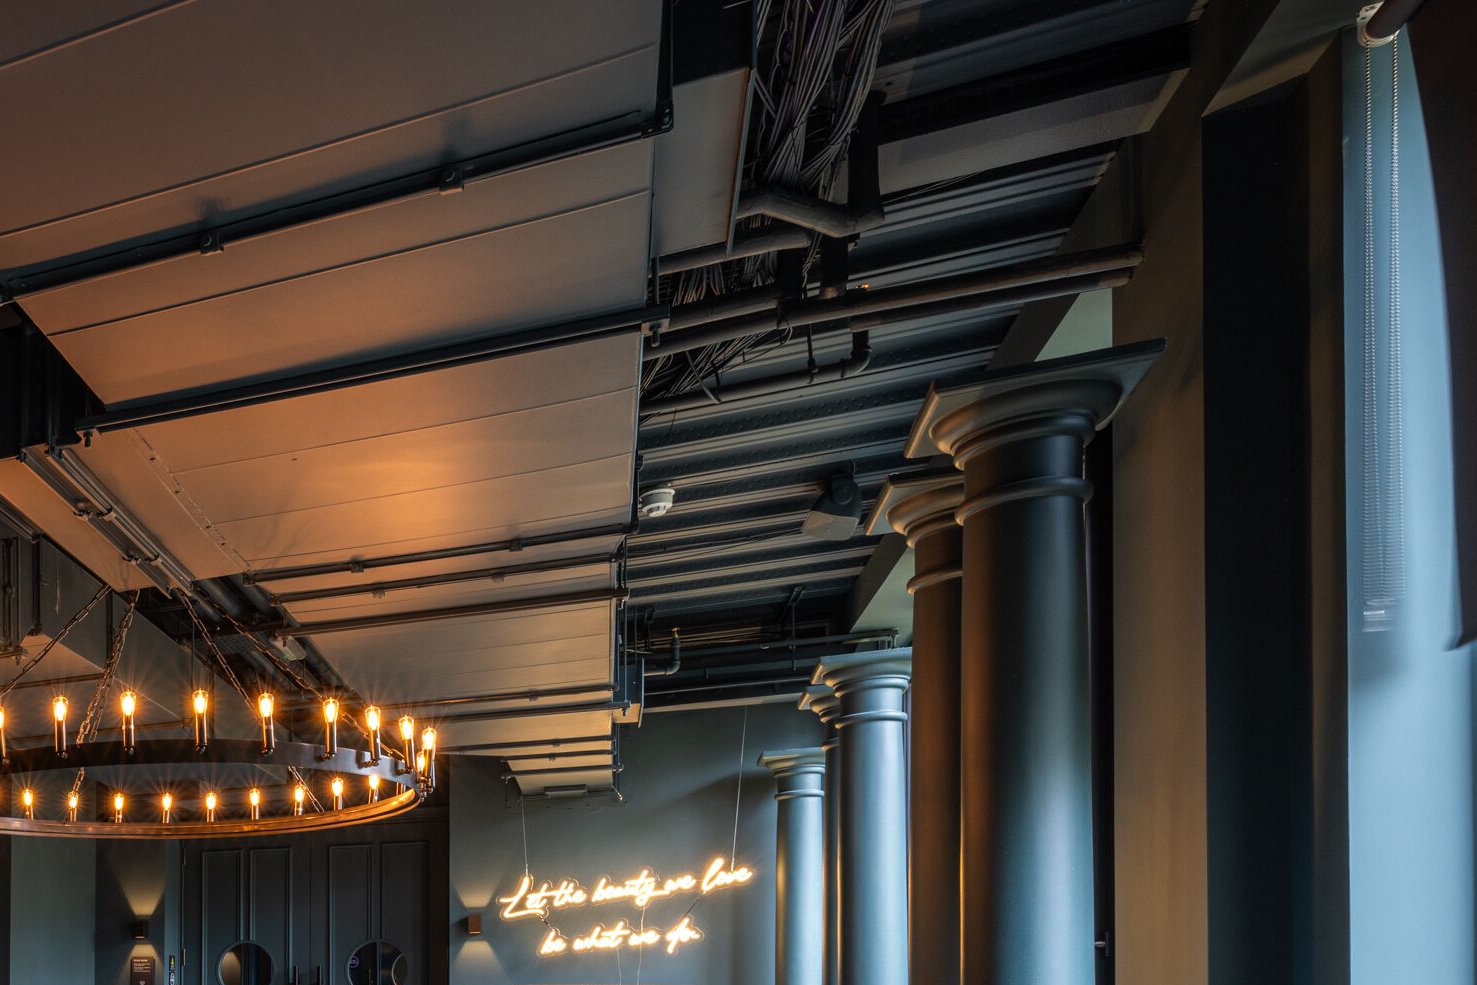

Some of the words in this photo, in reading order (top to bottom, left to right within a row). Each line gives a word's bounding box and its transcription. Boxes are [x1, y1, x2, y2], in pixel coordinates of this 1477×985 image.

[499, 876, 548, 918] Let
[552, 880, 587, 906] the
[591, 869, 668, 907] beauty
[665, 874, 696, 893] we
[701, 857, 753, 892] love
[539, 930, 566, 954] be
[573, 921, 630, 951] what
[628, 928, 660, 947] we
[666, 917, 701, 954] do
